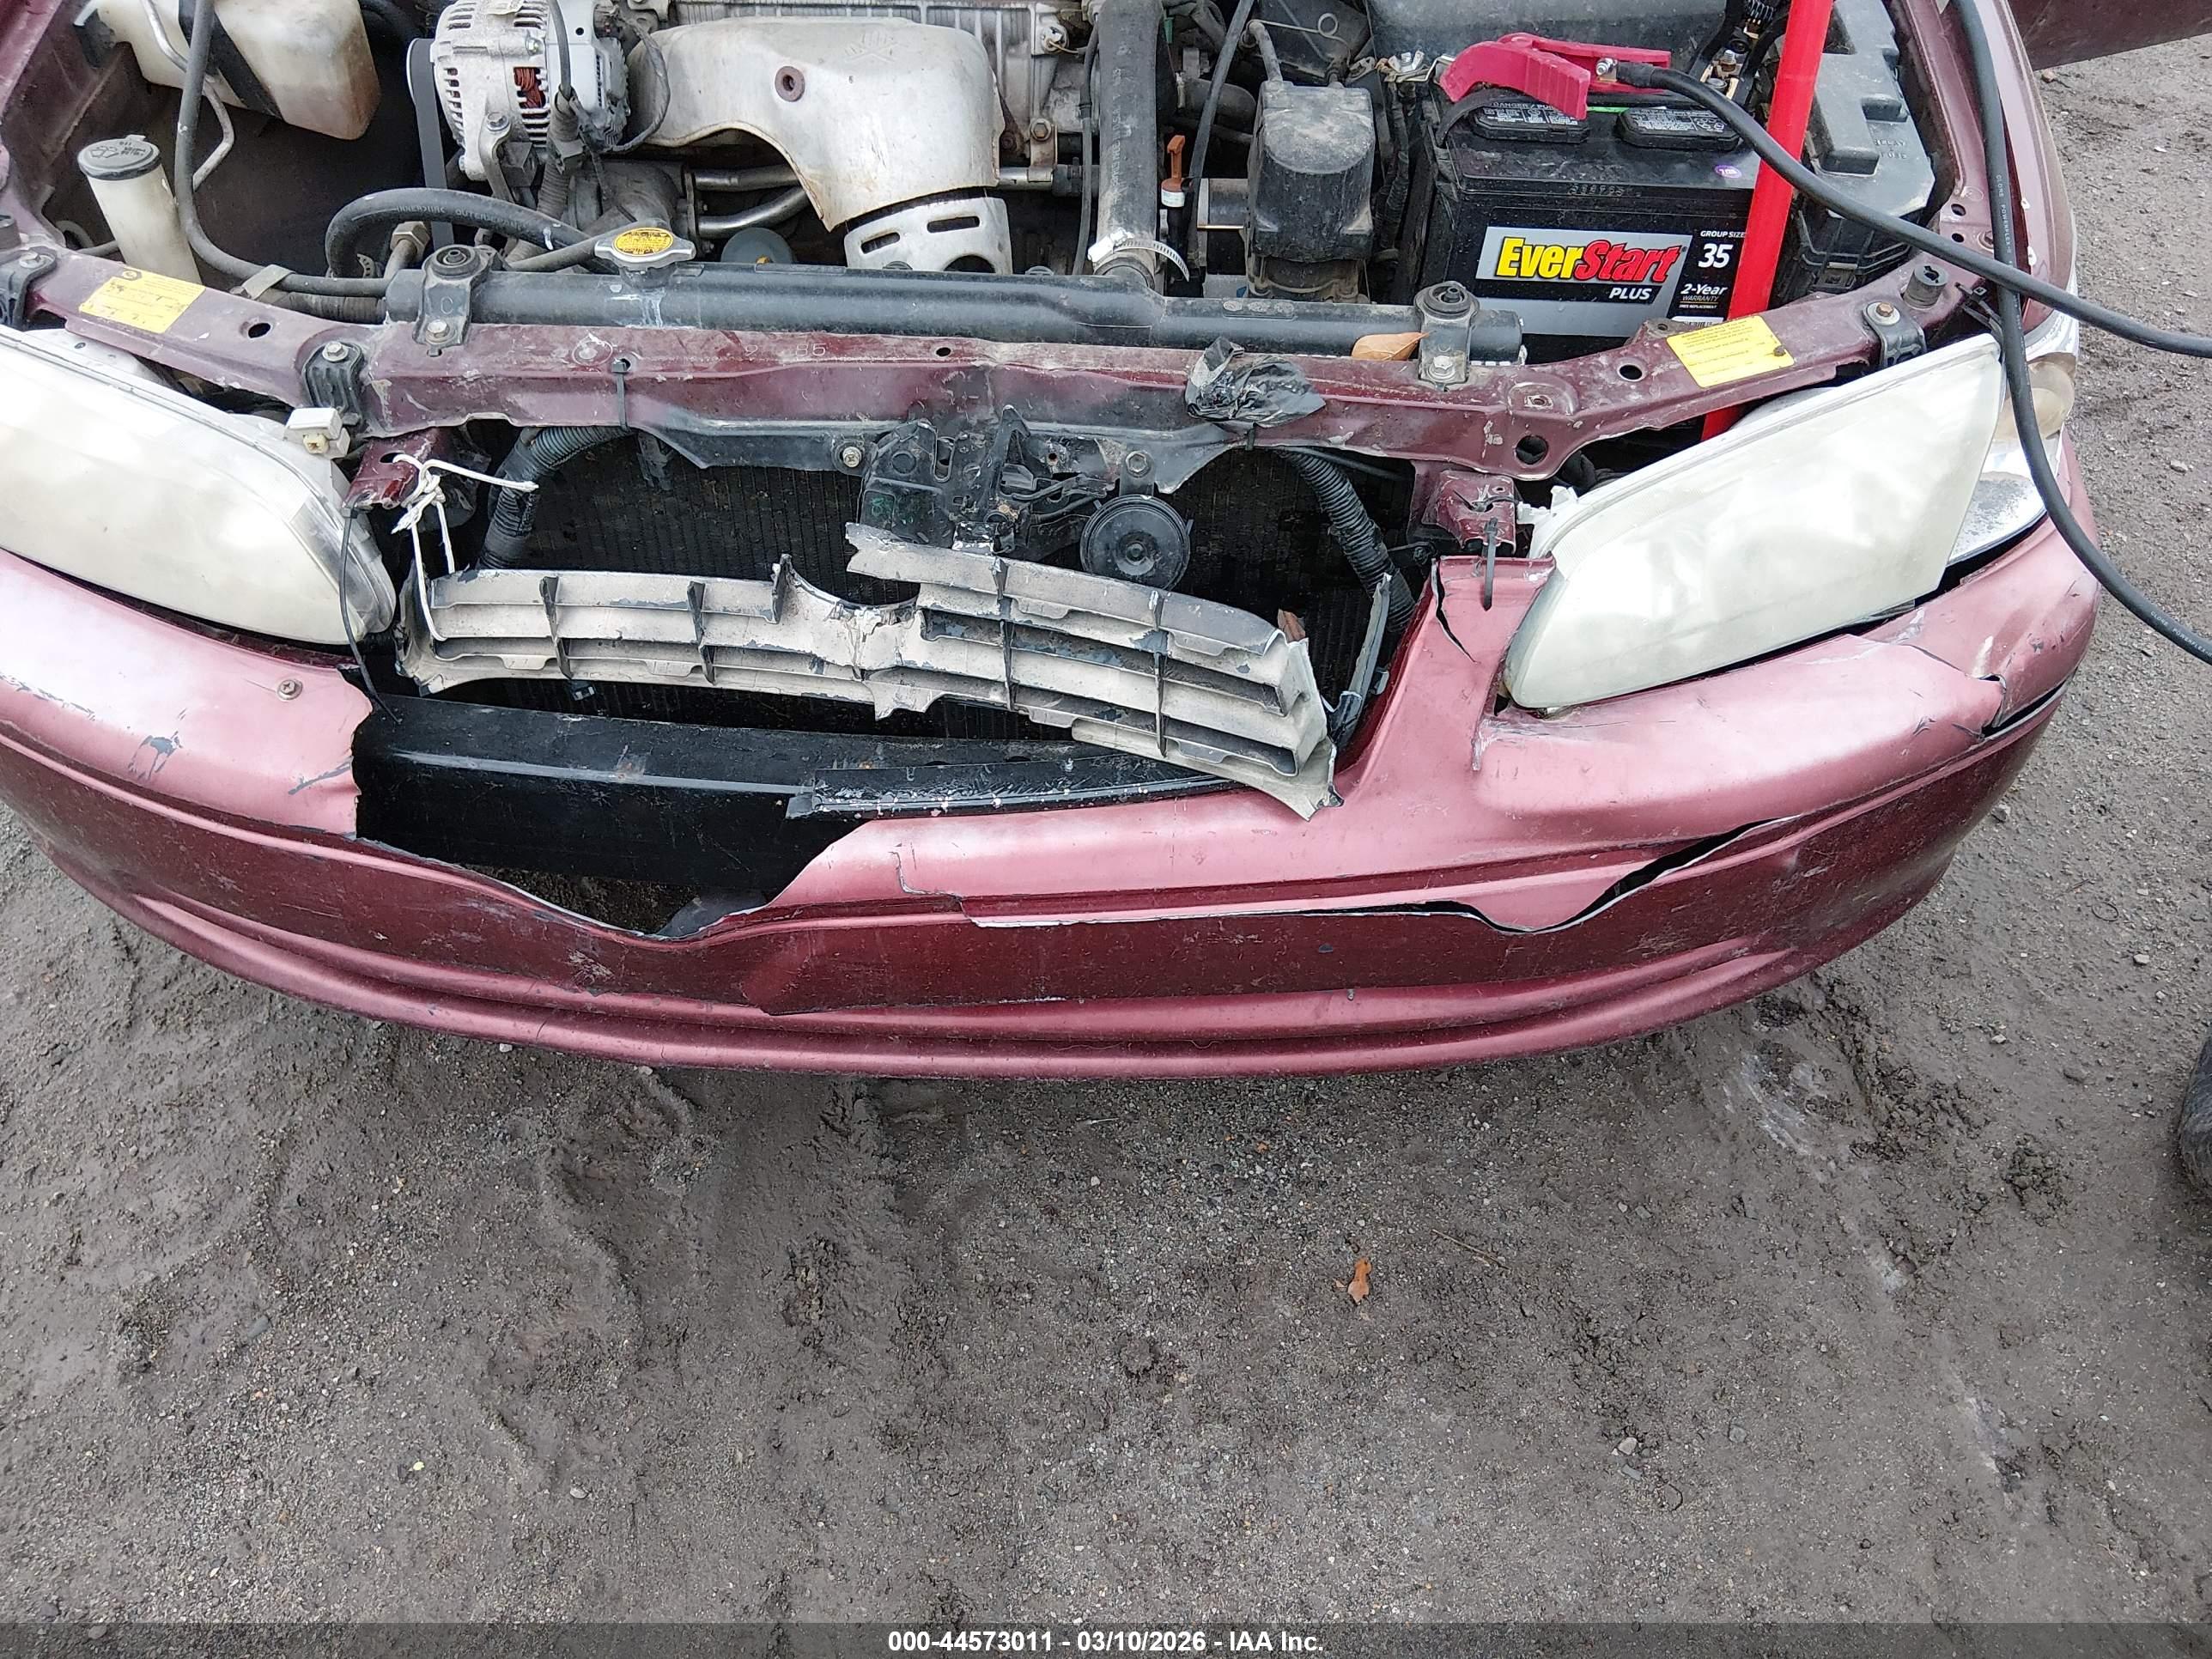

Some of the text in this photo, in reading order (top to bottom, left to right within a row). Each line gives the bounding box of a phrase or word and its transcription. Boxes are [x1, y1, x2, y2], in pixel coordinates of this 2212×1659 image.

[1496, 236, 1681, 284] EverStart
[1698, 243, 1733, 268] 35
[1608, 287, 1652, 300] PLUS
[1680, 283, 1728, 295] 2-Year
